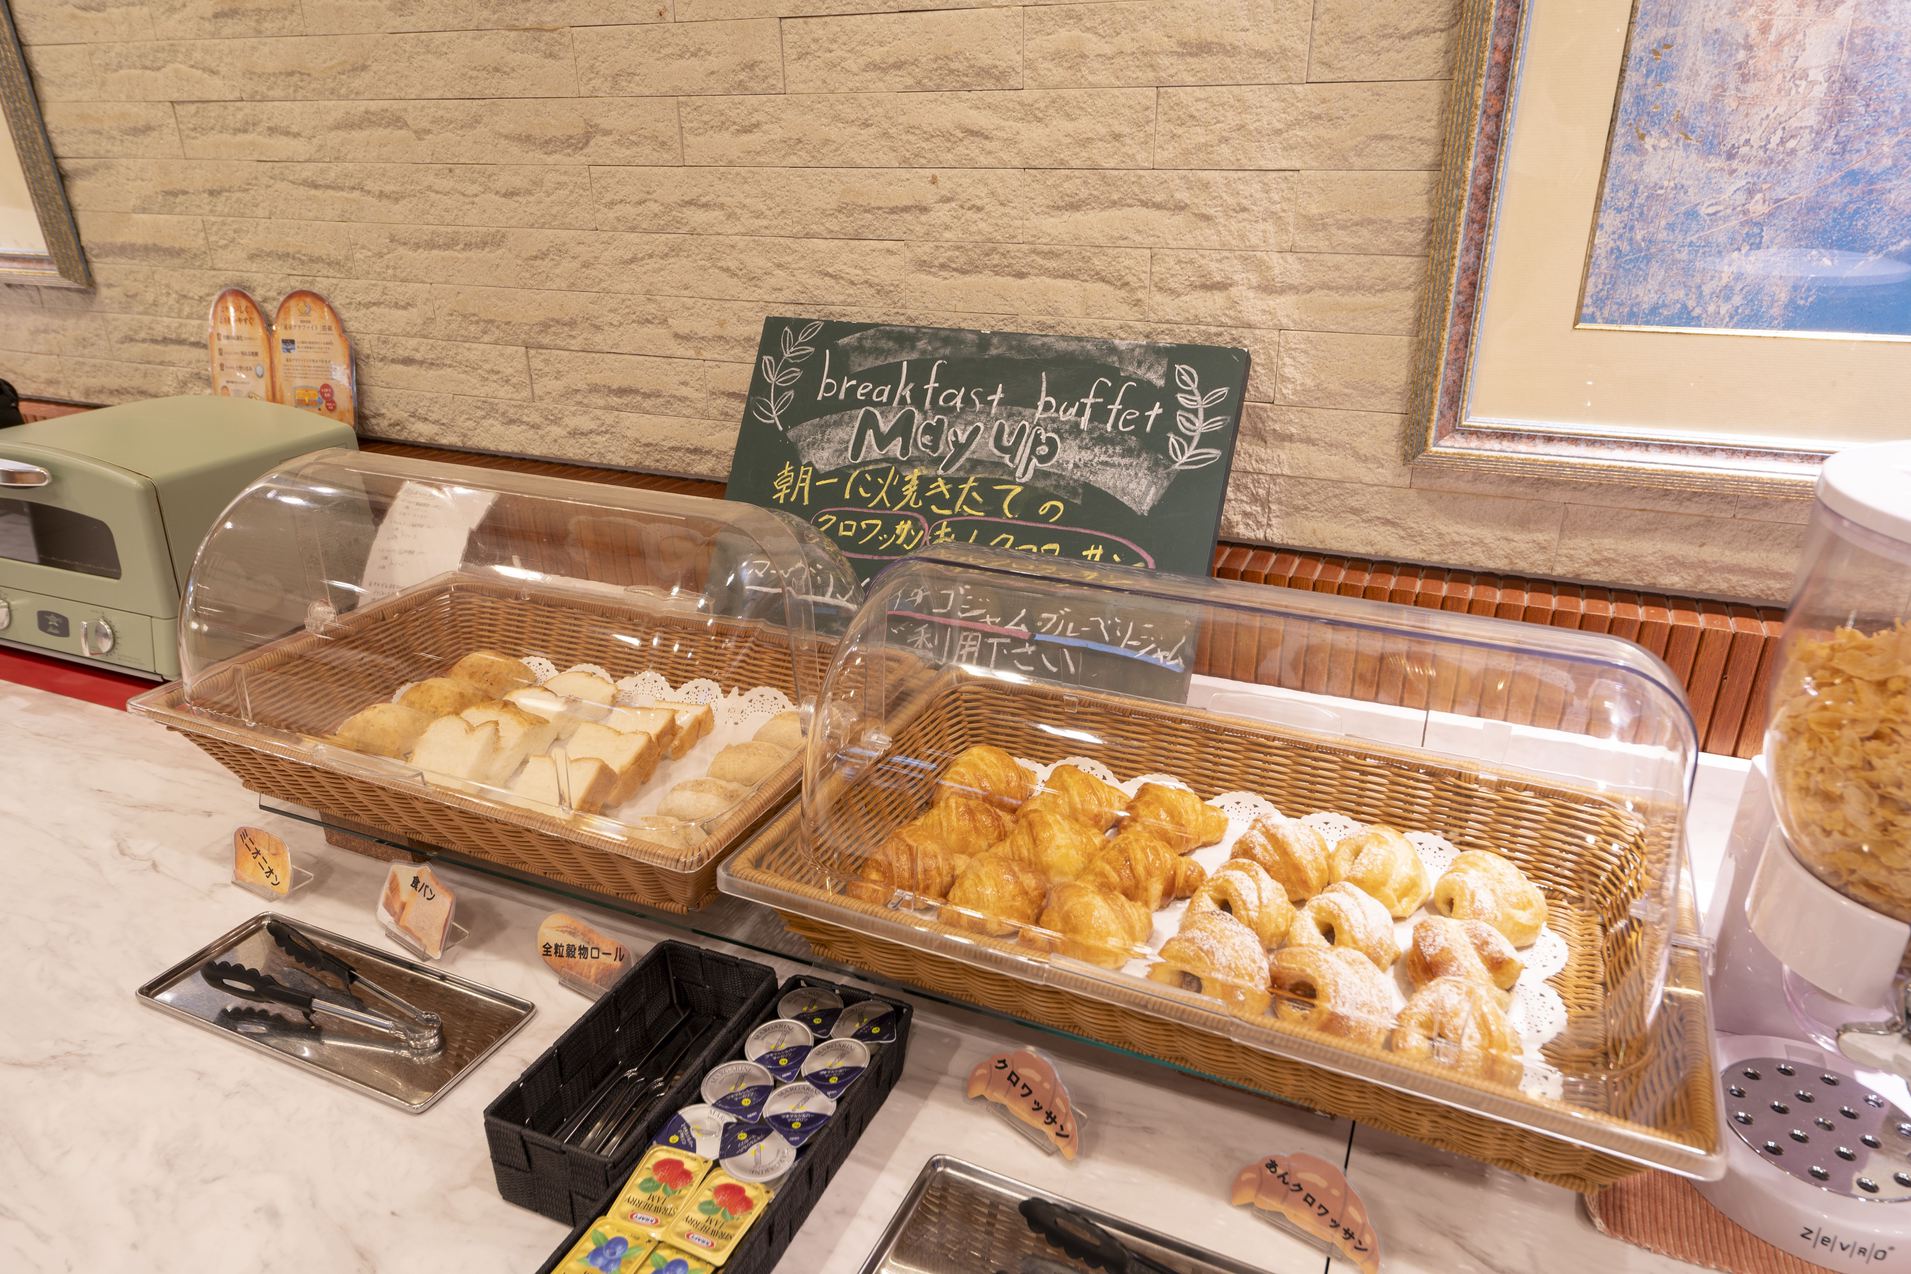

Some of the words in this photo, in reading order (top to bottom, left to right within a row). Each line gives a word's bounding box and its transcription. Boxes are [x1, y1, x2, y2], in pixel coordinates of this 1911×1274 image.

[817, 349, 1005, 416] breakfast
[1034, 371, 1163, 432] buffet
[818, 514, 924, 550] クロワッサン
[240, 829, 280, 887] ミニオニオン
[409, 875, 436, 901] 食パン
[542, 942, 625, 961] 全粒穀物ロール
[995, 1059, 1070, 1138] クロワッサン
[1265, 1159, 1369, 1253] あんクロワッサン
